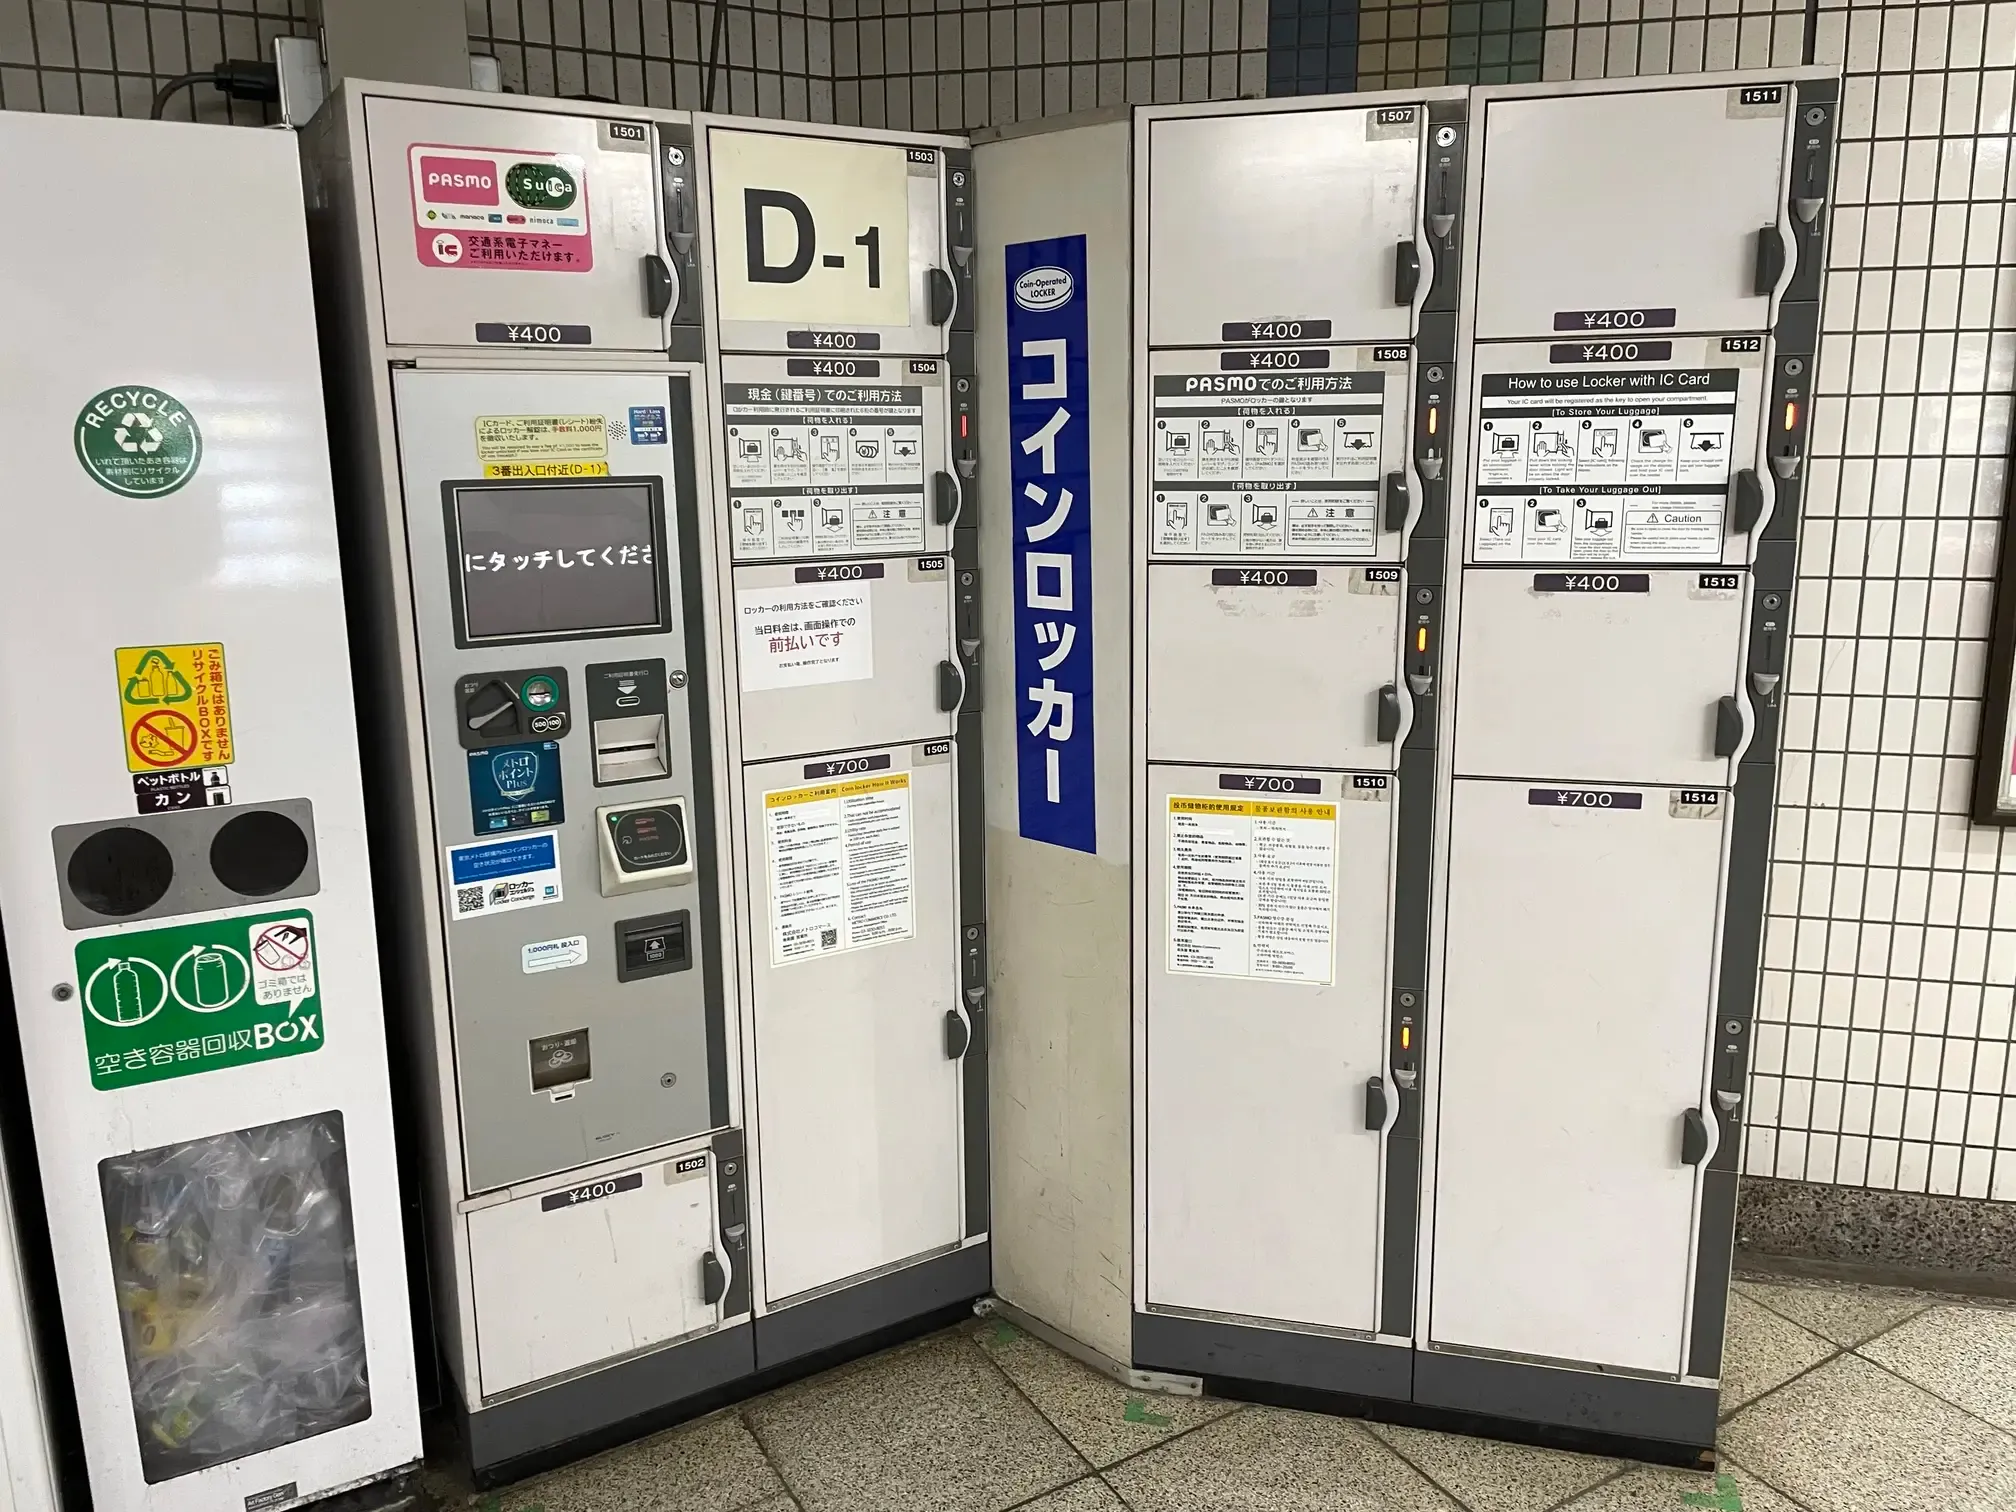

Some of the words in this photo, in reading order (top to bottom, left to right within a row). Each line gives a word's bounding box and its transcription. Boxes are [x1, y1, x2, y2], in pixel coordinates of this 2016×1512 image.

[1744, 91, 1778, 102] 1511
[1380, 110, 1412, 122] 1507
[613, 126, 642, 138] 1501
[909, 152, 933, 162] 1503
[428, 173, 492, 189] PASMO
[523, 178, 573, 193] Suica
[530, 216, 553, 224] nimoca
[468, 236, 562, 250] 交通系電子マネー
[744, 188, 880, 288] D-1
[1020, 276, 1066, 288] Coin-Operated
[1031, 288, 1055, 298] LOCKER
[1584, 312, 1644, 328] ¥400
[508, 325, 561, 342] ¥400
[1251, 324, 1302, 338] ¥400
[813, 334, 856, 348] ¥400
[1725, 340, 1758, 350] 1512
[1377, 350, 1407, 359] 1508
[1582, 345, 1638, 360] ¥400
[1250, 352, 1300, 368] ¥400
[813, 362, 856, 375] ¥400
[912, 364, 936, 372] 1504
[1186, 376, 1352, 392] PASMOでのご利用方法
[1508, 378, 1536, 388] How
[1540, 378, 1552, 388] to
[1556, 378, 1578, 387] use
[1582, 376, 1626, 387] Locker
[1630, 374, 1655, 386] with
[1660, 374, 1674, 386] IC
[1678, 373, 1710, 385] Card
[85, 391, 186, 428] RECYCLE
[1238, 407, 1296, 416] 【荷物を入れる】
[124, 477, 164, 485] しています
[1232, 482, 1297, 490] 【荷物を取り出す】
[1601, 486, 1638, 494] Luggage
[1664, 514, 1702, 523] Caution
[921, 560, 943, 569] 1505
[1022, 338, 1077, 803] コインロッカー
[817, 566, 862, 580] ¥400
[1240, 571, 1288, 584] ¥400
[1369, 572, 1398, 580] 1509
[1565, 576, 1619, 590] ¥400
[1703, 577, 1736, 587] 1513
[744, 598, 863, 614] ロッカーの利用方法をご確認ください
[755, 618, 855, 635] 当日料金は、画面操作での
[769, 631, 843, 653] 前払いです
[193, 650, 214, 761] リサイクルBOXです
[208, 649, 230, 760] ごみ箱ではありません
[927, 744, 948, 754] 1506
[826, 759, 869, 775] ¥700
[137, 772, 200, 786] ペットボトル
[506, 779, 527, 789] Plus
[1245, 776, 1294, 792] ¥700
[1356, 779, 1384, 787] 1510
[155, 792, 190, 806] カン
[1557, 792, 1613, 807] ¥700
[1684, 793, 1715, 802] 1514
[509, 881, 534, 890] ロッカー
[258, 975, 307, 988] ゴミ箱では
[262, 985, 312, 1000] ありません
[95, 1014, 319, 1075] 空き容器回収BOX
[679, 1159, 704, 1172] 1502
[569, 1181, 616, 1203] ¥400
